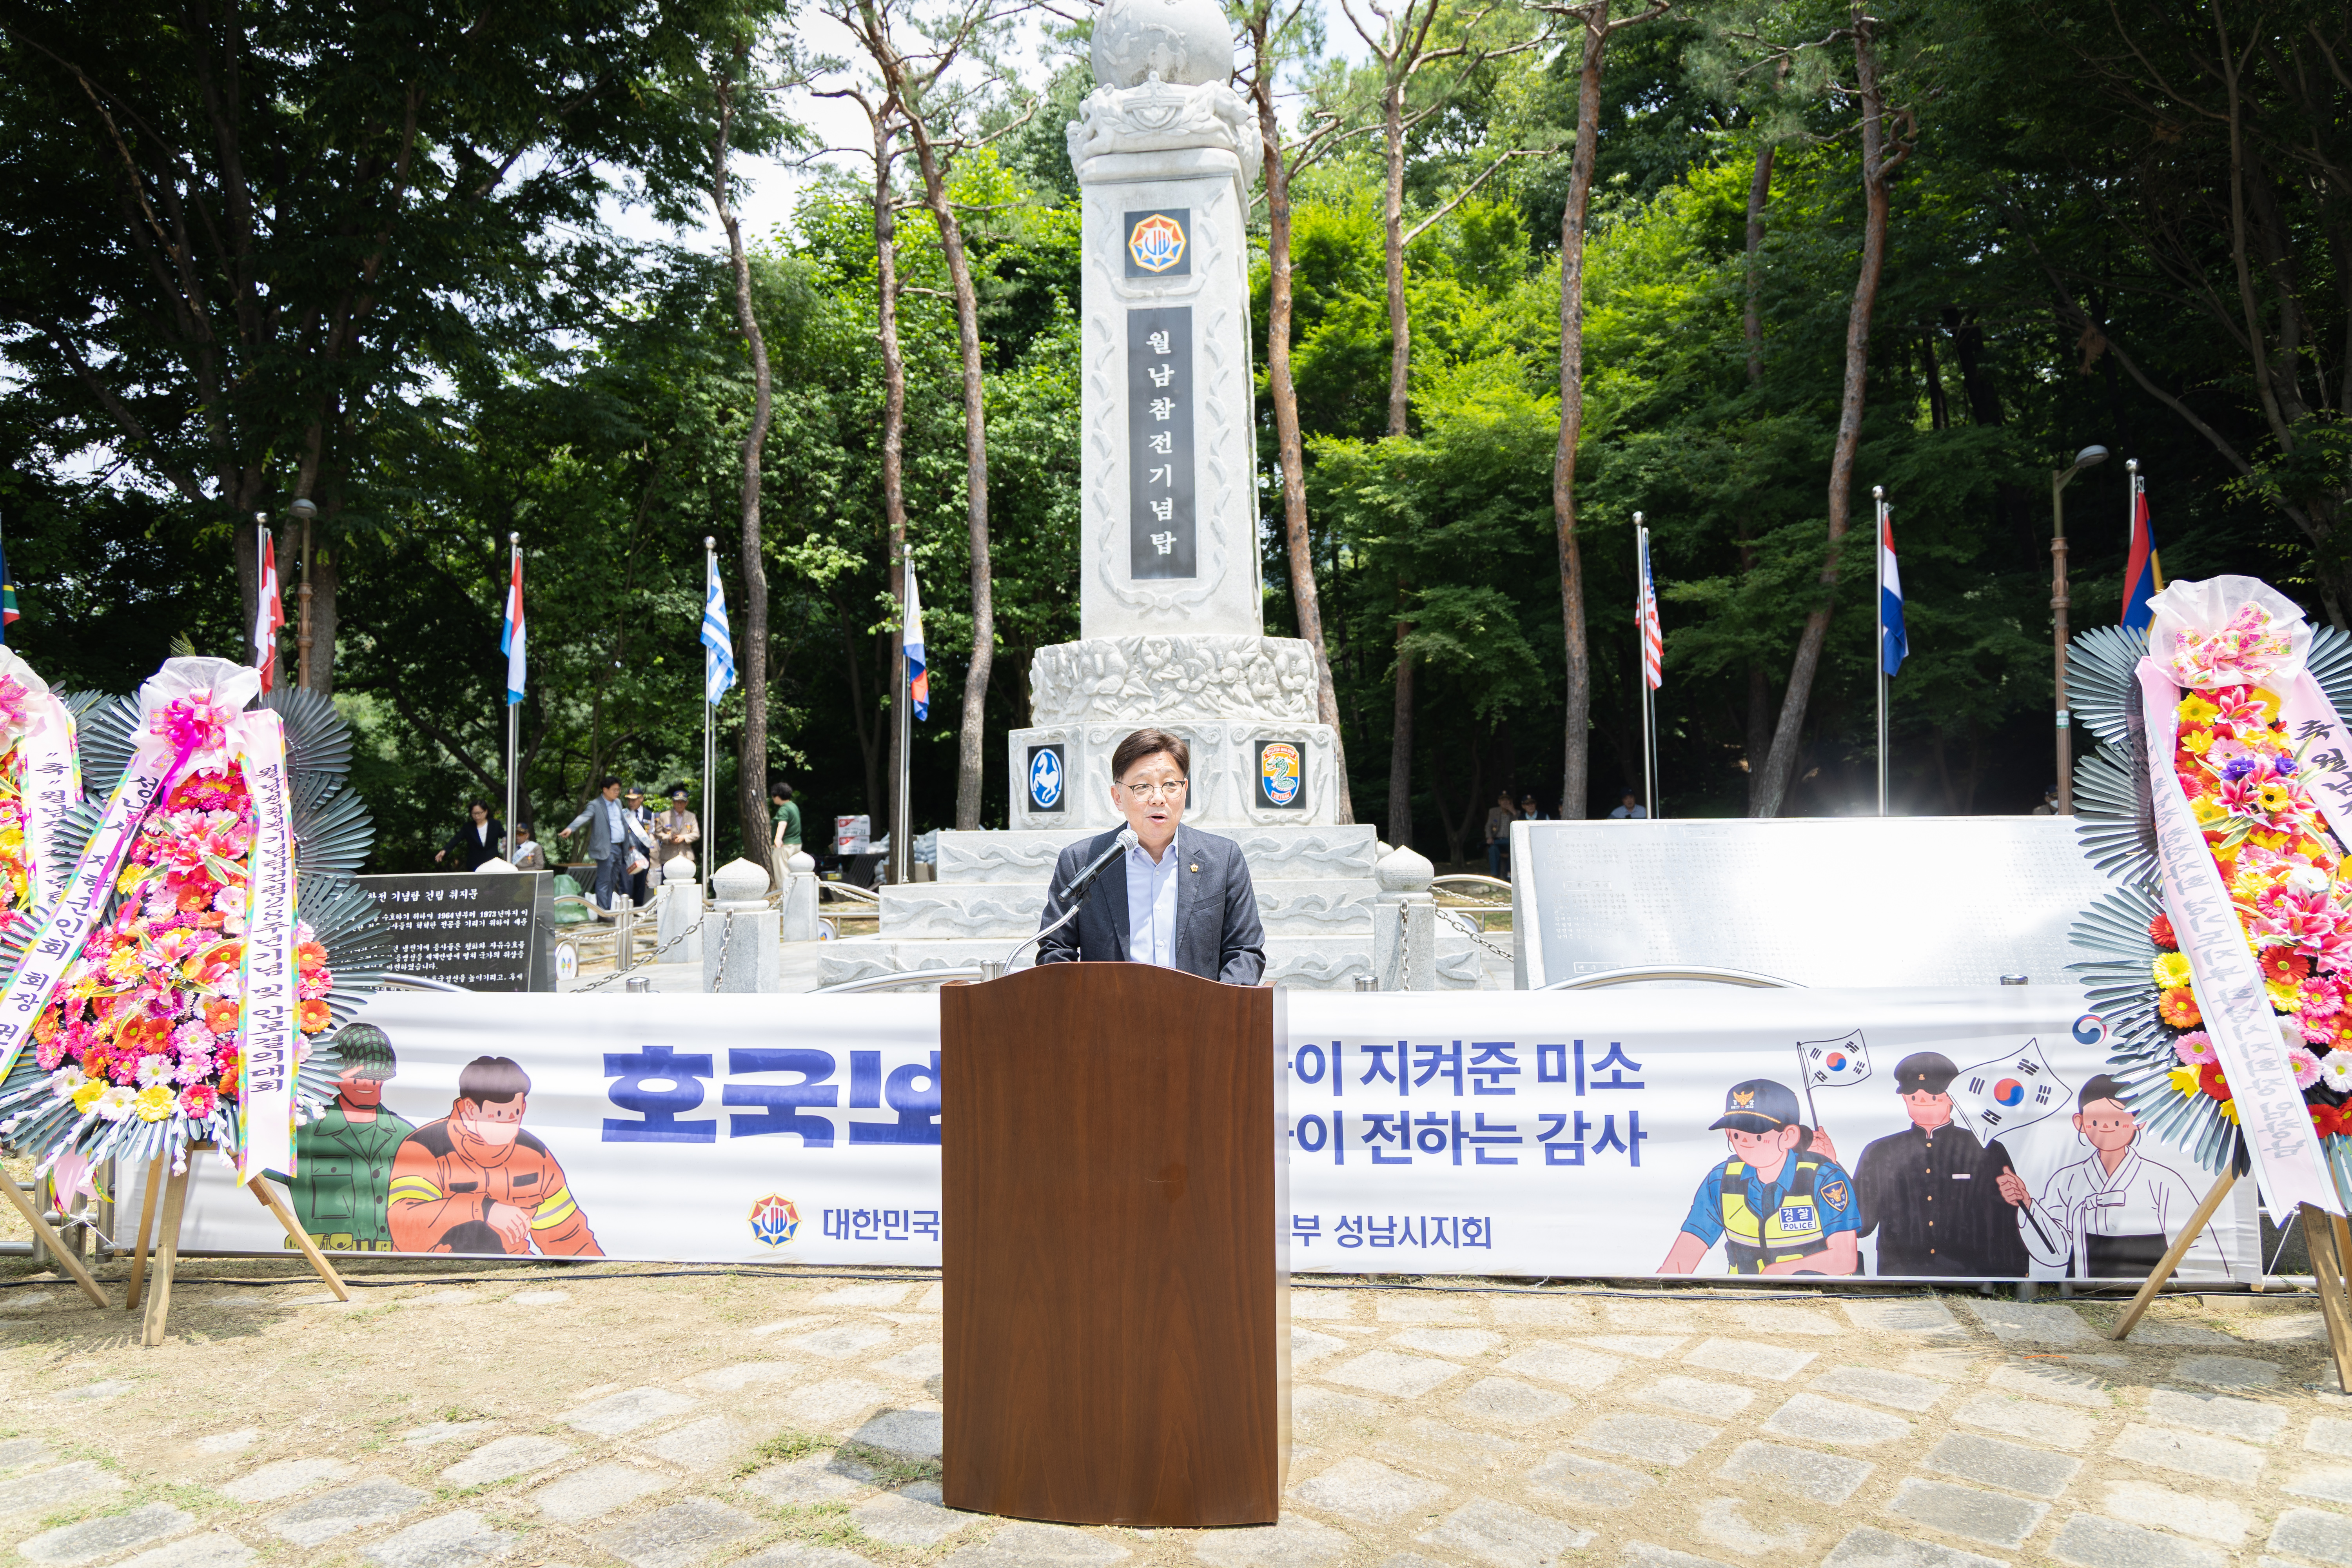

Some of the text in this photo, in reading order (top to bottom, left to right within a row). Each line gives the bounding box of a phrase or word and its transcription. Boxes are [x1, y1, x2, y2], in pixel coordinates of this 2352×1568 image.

[1146, 330, 1177, 555] 월남참전기념탑
[391, 890, 420, 902] 기념탑
[425, 889, 444, 901] 건립
[449, 888, 478, 900] 취지문
[381, 912, 410, 921] 수호하기
[412, 911, 434, 920] 위하여
[437, 910, 476, 920] 1964년부터
[480, 909, 518, 918] 1973년까지
[521, 908, 528, 916] 이
[416, 921, 437, 929] 혁혁한
[440, 920, 461, 929] 전공을
[465, 919, 486, 928] 기리기
[489, 918, 510, 927] 위하여
[513, 917, 528, 926] 세운
[402, 944, 430, 953] 냉전기에
[433, 942, 461, 952] 용사들은
[465, 942, 486, 951] 평화와
[490, 940, 525, 949] 자유수호를
[394, 953, 423, 962] 용맹성을
[479, 951, 500, 959] 국가의
[503, 950, 524, 959] 위상을
[386, 962, 438, 972] 마련하였습니다.
[468, 973, 506, 983] 높이기리고,
[508, 972, 523, 981] 후세
[9, 971, 49, 1012] 회장
[251, 984, 283, 999] 및
[248, 1005, 293, 1093] 안보결의대회
[1288, 1039, 1645, 1096] 이 지켜준 미소
[1289, 1110, 1648, 1167] 이 전하는 감사
[823, 1209, 940, 1241] 대한민국
[1292, 1215, 1491, 1249] 부 성남시지회
[1784, 1221, 1813, 1230] POLICE
